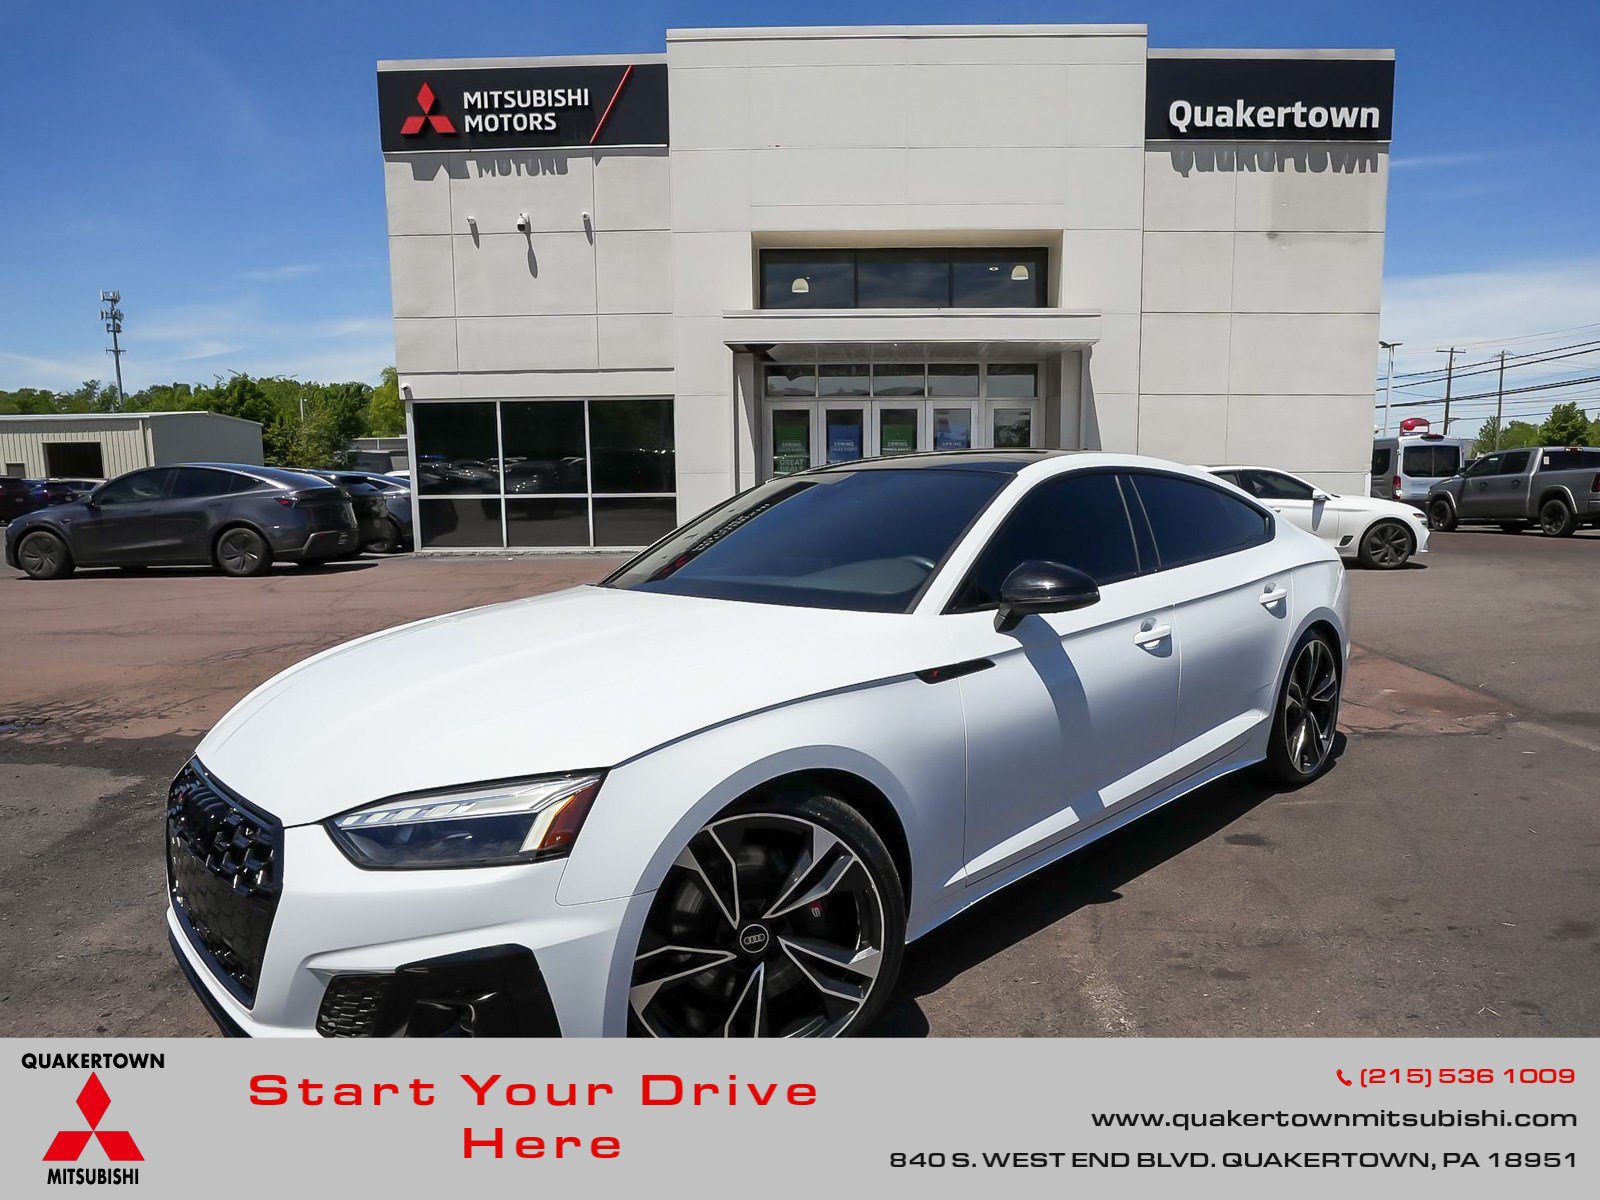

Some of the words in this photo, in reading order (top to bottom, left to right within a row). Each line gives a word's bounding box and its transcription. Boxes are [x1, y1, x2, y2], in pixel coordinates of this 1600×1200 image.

[463, 87, 590, 110] MITSUBISHI
[464, 112, 557, 133] MOTORS
[1168, 98, 1380, 133] Quakertown
